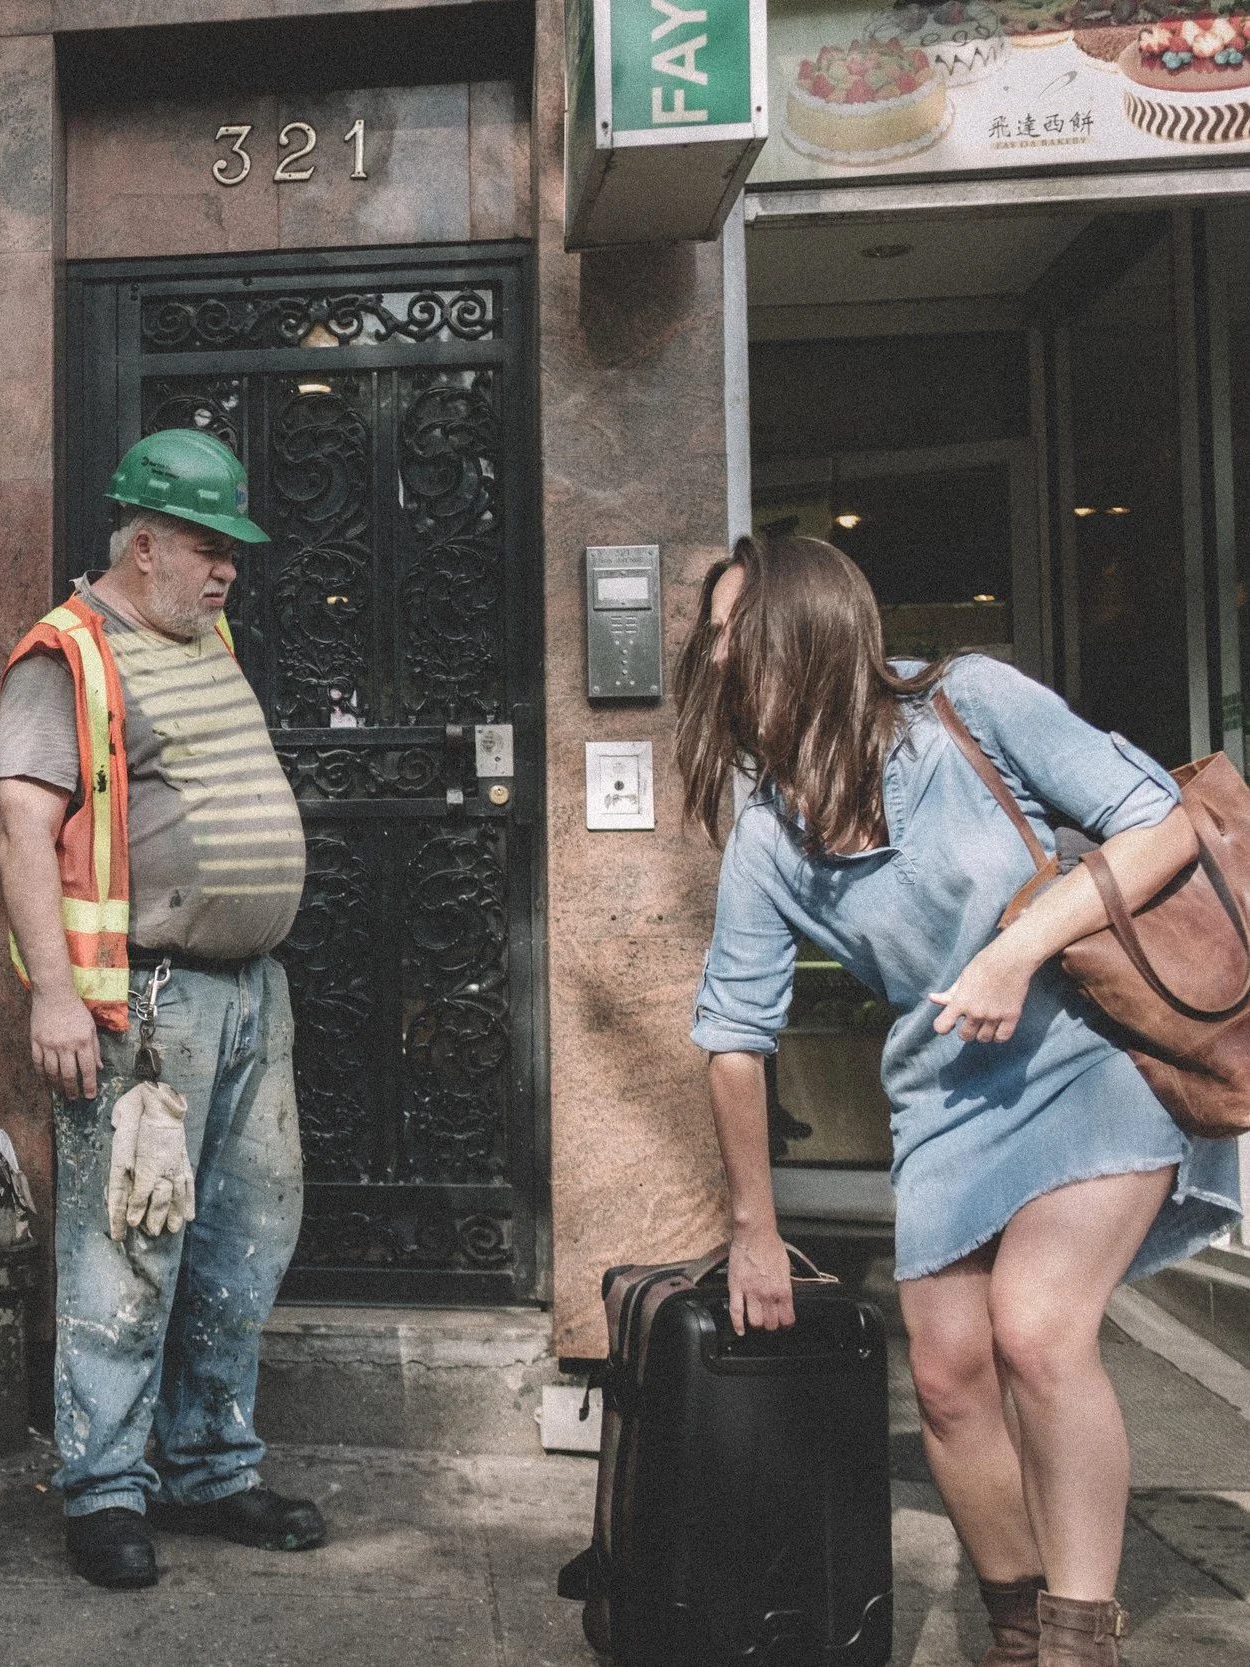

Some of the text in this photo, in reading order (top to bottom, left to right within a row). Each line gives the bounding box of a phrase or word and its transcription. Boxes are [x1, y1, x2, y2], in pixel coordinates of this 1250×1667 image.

[651, 0, 708, 123] FAY
[988, 110, 1094, 138] 飛達西餅
[1041, 137, 1087, 147] BAKERY
[212, 119, 368, 185] 321
